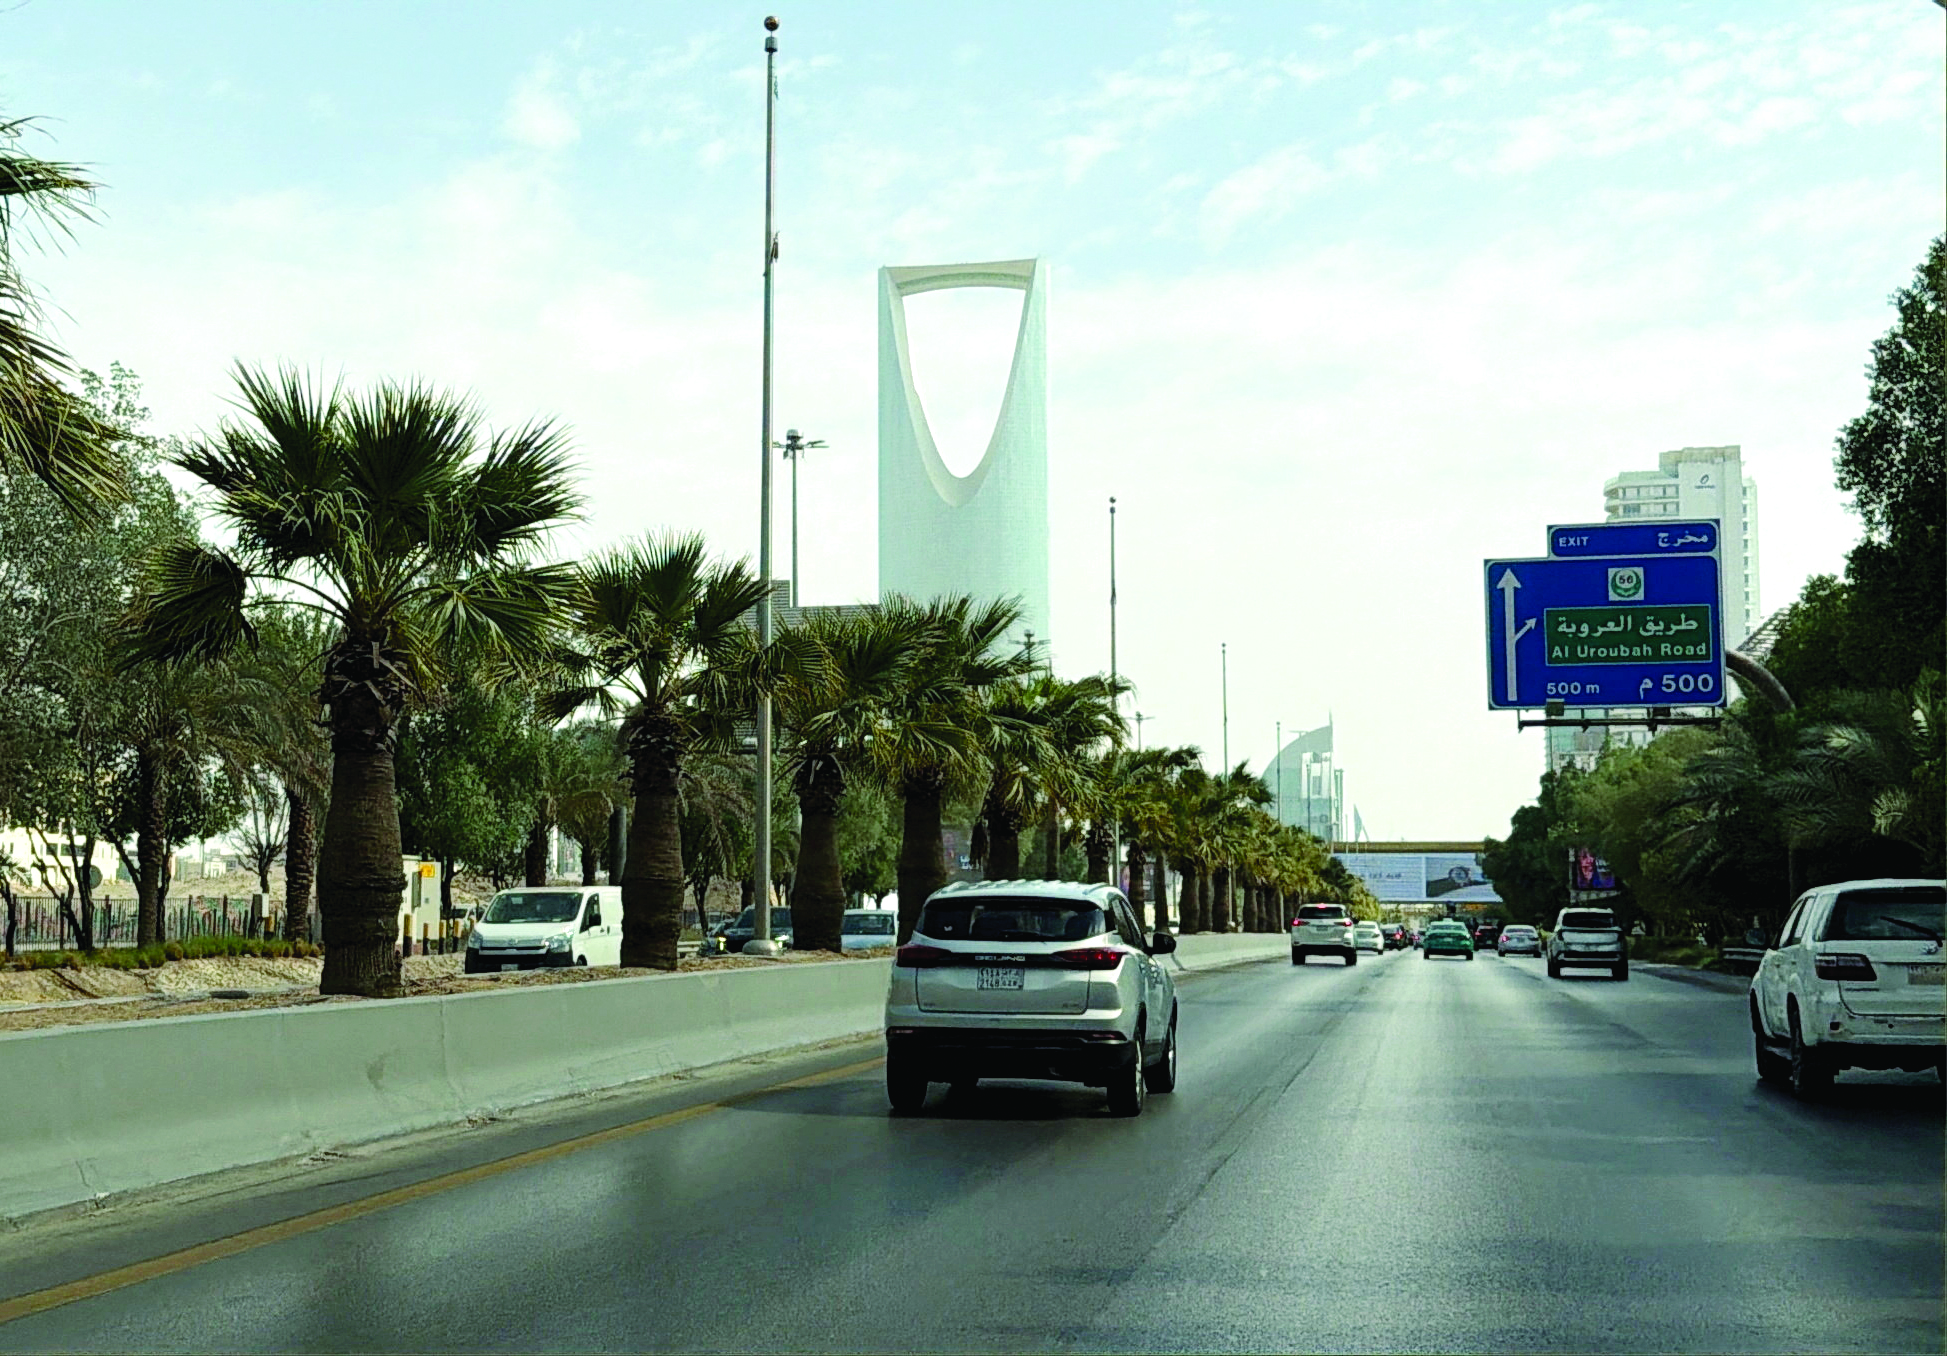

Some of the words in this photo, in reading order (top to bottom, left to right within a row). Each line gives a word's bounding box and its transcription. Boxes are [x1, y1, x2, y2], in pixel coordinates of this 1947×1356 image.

[1558, 536, 1589, 548] EXIT
[1657, 530, 1709, 548] مخرج
[1557, 614, 1633, 638] العروبة
[1639, 612, 1699, 636] طريق
[1551, 645, 1569, 658] Al
[1576, 643, 1653, 658] Uroubah
[1660, 642, 1707, 656] Road
[1546, 681, 1581, 695] 500
[1585, 683, 1600, 694] m
[1639, 677, 1654, 700] م
[1661, 673, 1714, 693] 500
